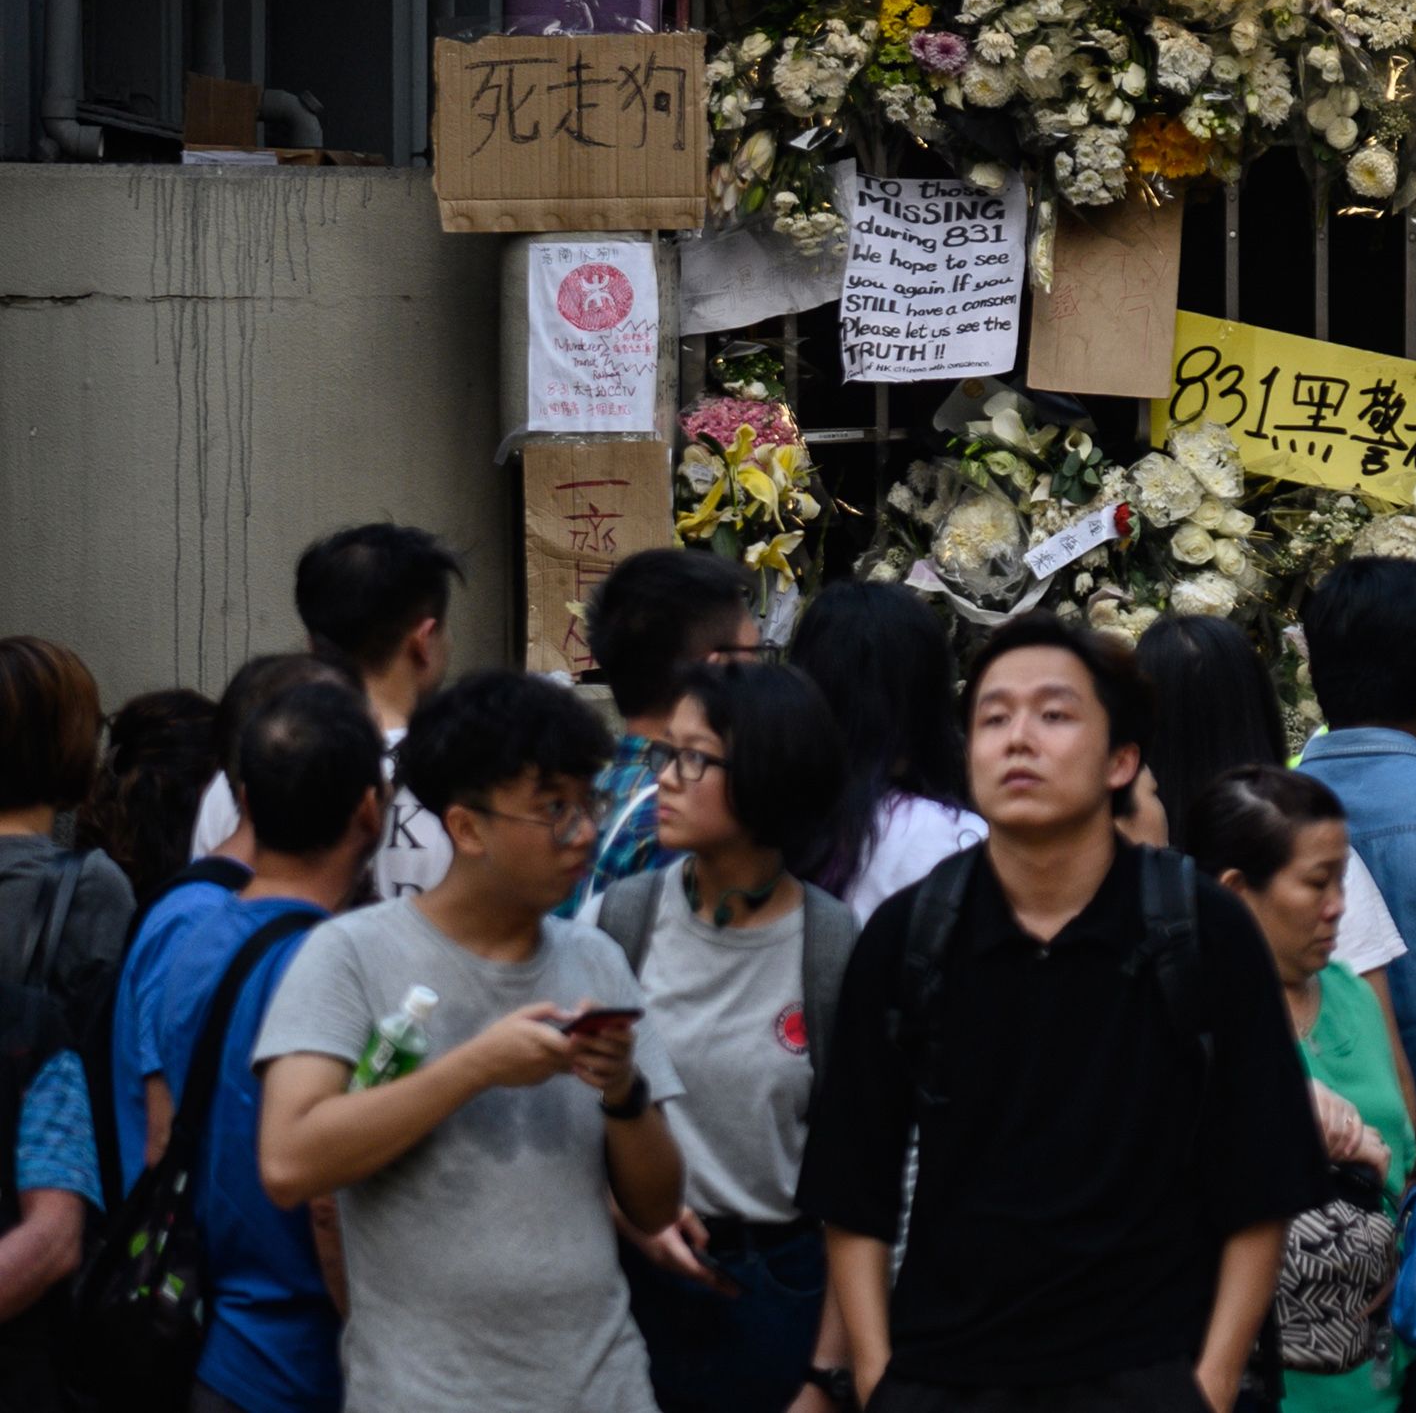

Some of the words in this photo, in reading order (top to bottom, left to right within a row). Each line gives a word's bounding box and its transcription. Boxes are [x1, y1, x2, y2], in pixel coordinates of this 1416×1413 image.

[465, 49, 687, 158] 死走狗
[857, 190, 1007, 225] MISSING
[856, 215, 937, 253] during
[942, 223, 1008, 248] 831
[852, 243, 882, 264] We
[889, 248, 938, 275] hope
[945, 254, 968, 270] to
[974, 252, 1010, 267] see
[846, 274, 888, 290] you
[952, 273, 973, 294] If
[972, 275, 1015, 292] you
[845, 293, 900, 314] STILL
[905, 302, 944, 317] have
[945, 304, 958, 316] a
[841, 315, 901, 342] Please
[905, 320, 928, 339] let
[931, 326, 951, 338] us
[956, 320, 981, 335] see
[983, 316, 1013, 332] the
[843, 340, 927, 366] TRUTH
